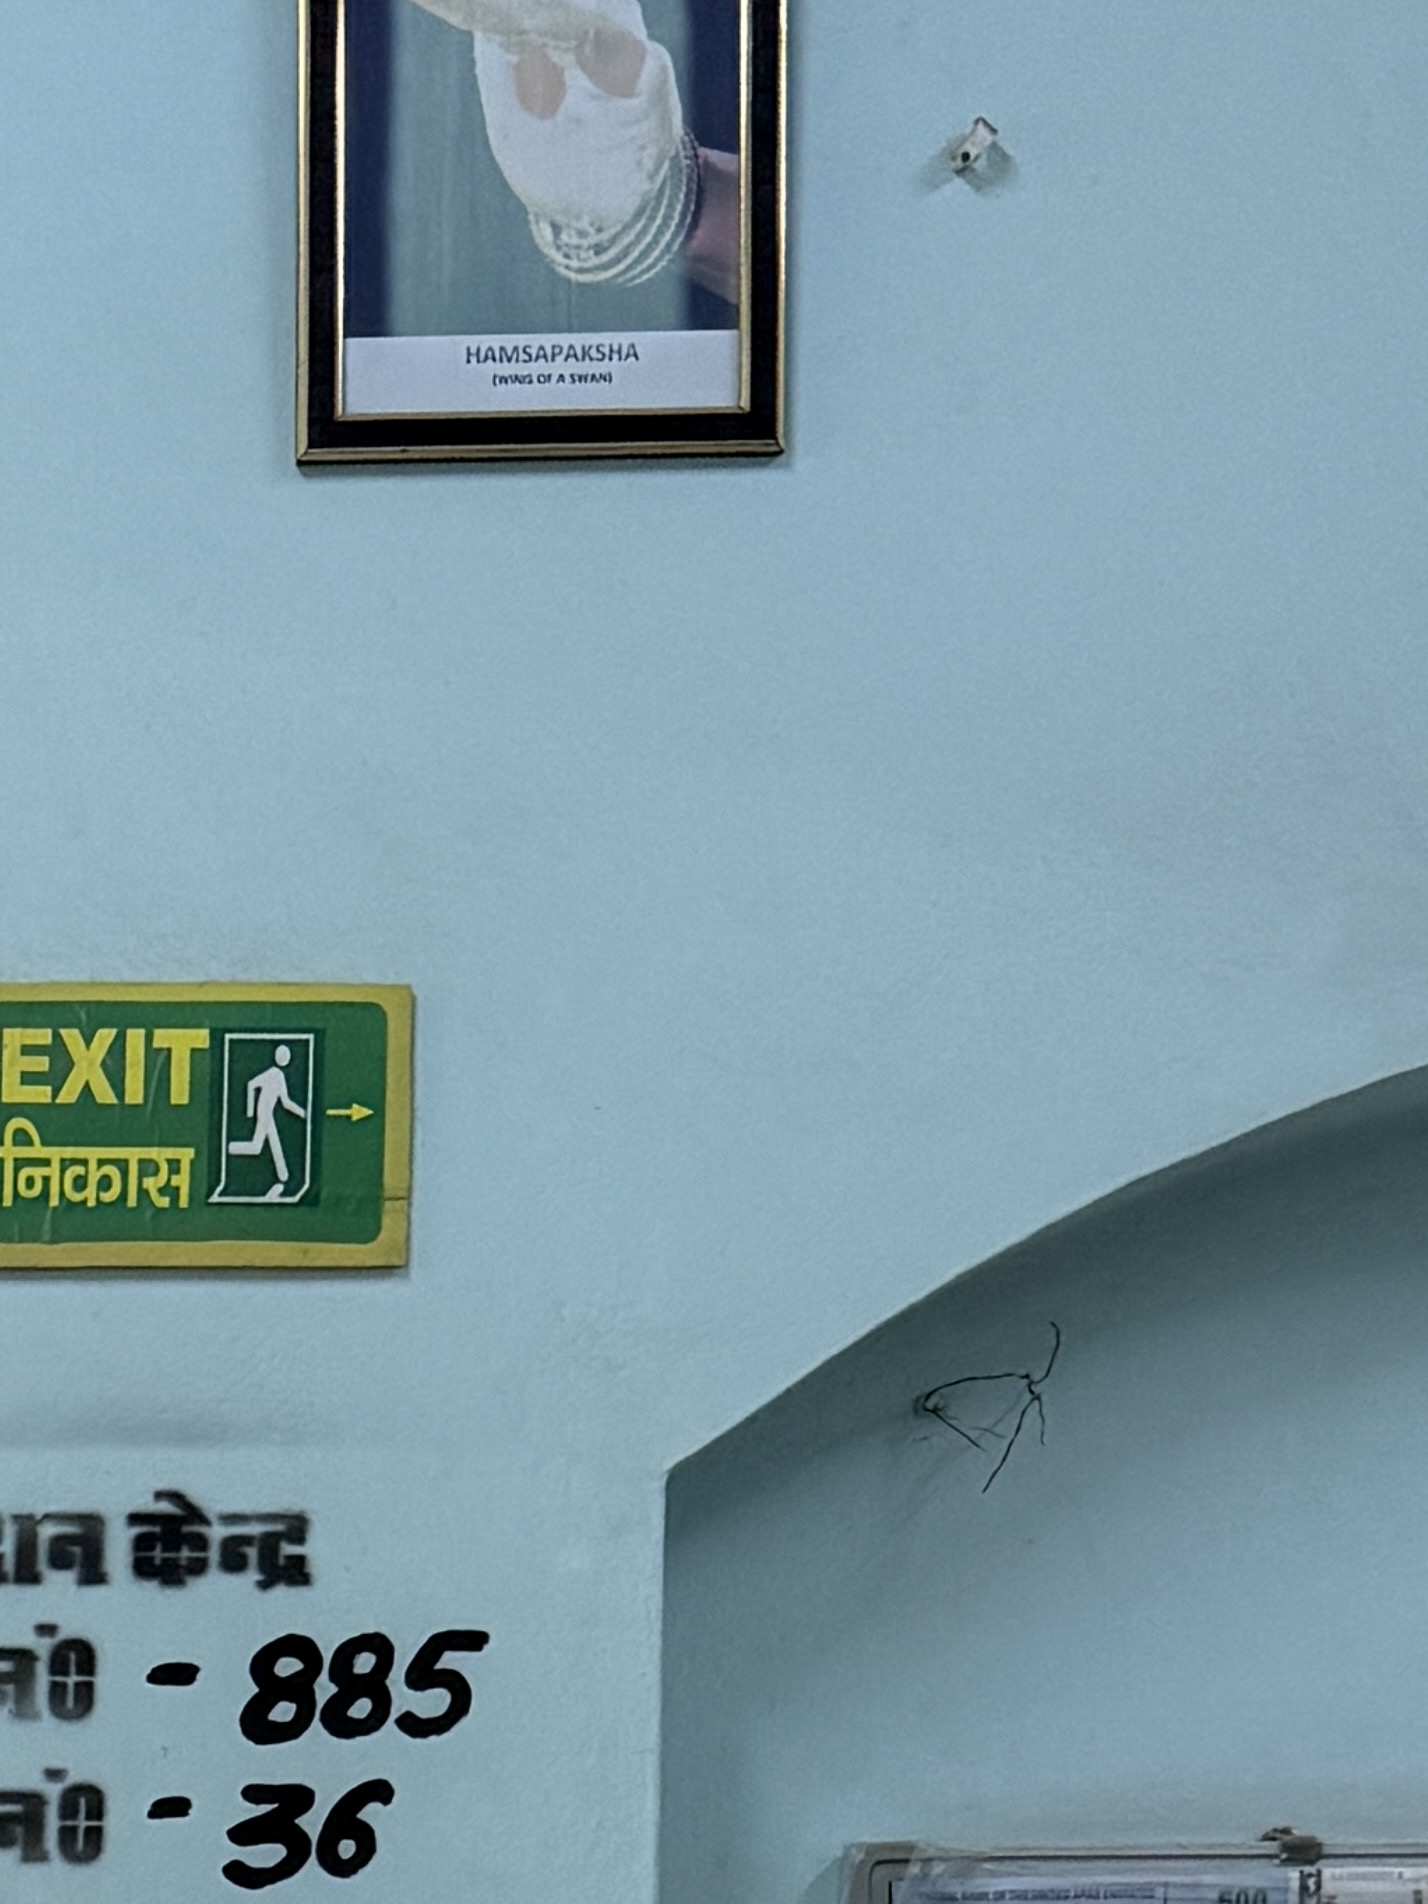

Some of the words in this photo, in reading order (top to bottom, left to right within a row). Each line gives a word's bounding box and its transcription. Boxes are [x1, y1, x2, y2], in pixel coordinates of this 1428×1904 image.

[465, 342, 639, 365] HAMSAPAKSHA
[0, 1028, 210, 1105] EXIT
[0, 1116, 195, 1209] निकास
[126, 1491, 312, 1592] केन्द्र
[238, 1629, 489, 1745] 885
[222, 1778, 395, 1890] 36
